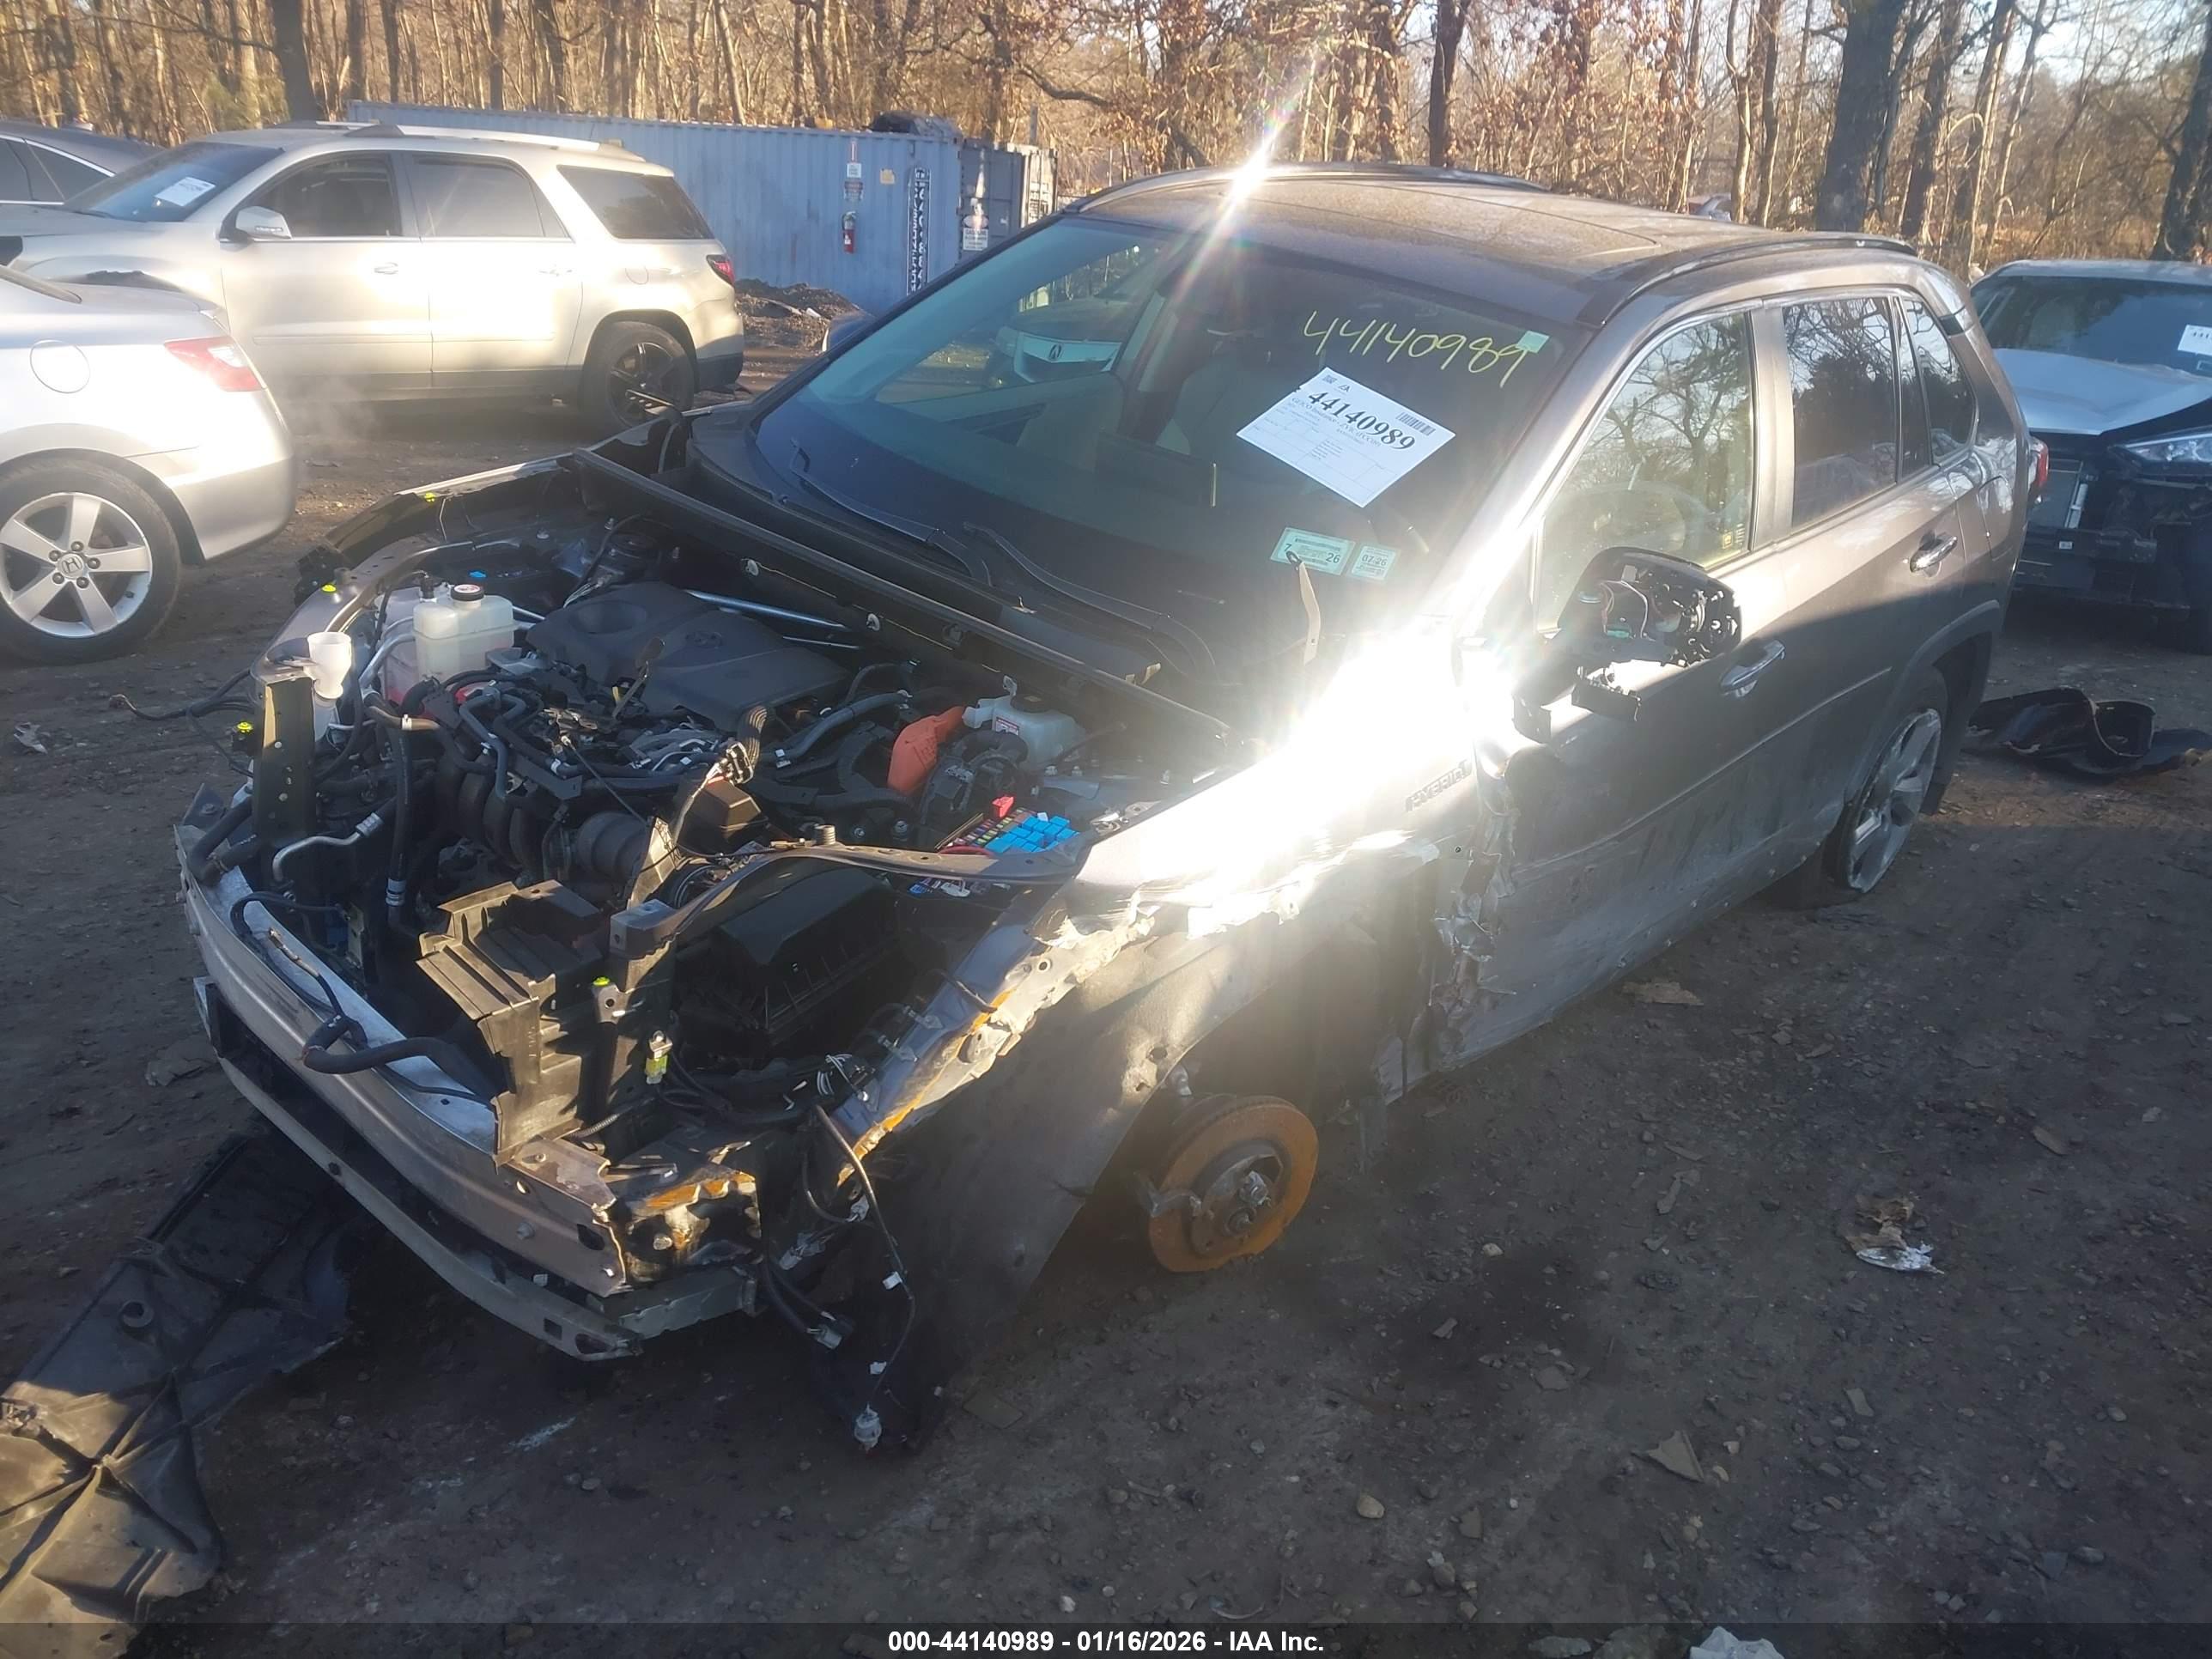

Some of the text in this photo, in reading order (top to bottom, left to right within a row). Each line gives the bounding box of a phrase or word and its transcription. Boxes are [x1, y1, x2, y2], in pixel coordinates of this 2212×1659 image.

[1304, 310, 1529, 388] 44140989
[1308, 392, 1416, 450] 44140989
[1325, 552, 1340, 564] 26
